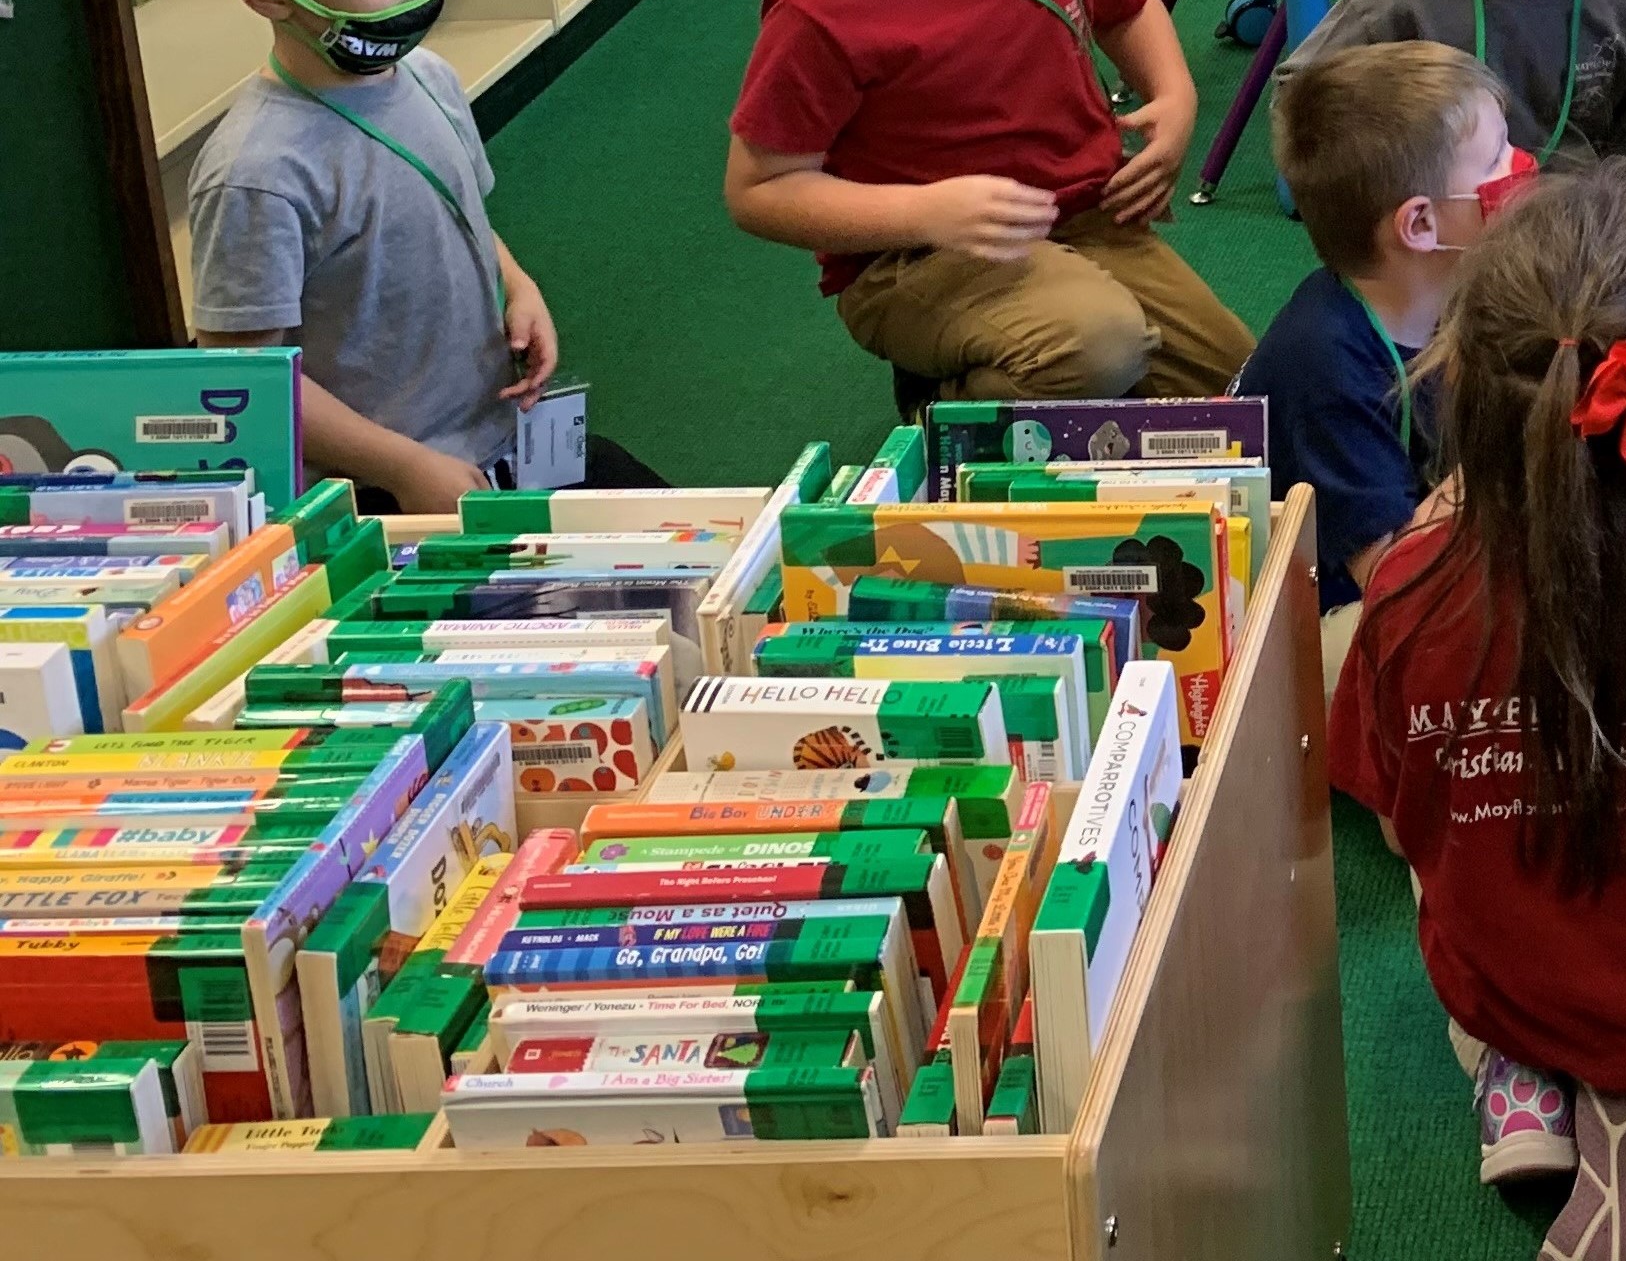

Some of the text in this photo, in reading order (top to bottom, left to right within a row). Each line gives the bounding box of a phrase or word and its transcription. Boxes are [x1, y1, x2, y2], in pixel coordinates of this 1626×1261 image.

[890, 638, 941, 652] Blue
[949, 637, 1016, 652] Little
[739, 685, 902, 706] HELLO HELLO
[1189, 672, 1211, 737] Highlights
[203, 736, 257, 747] TIGER
[1078, 720, 1137, 847] COMPARROTIVES
[115, 828, 218, 844] #baby
[650, 843, 726, 859] Stampede
[15, 870, 145, 885] Happy Giraffe!
[88, 890, 150, 907] FOX
[606, 900, 788, 924] Quiet as a Mouse
[521, 932, 600, 944] REYNOLDS MACK
[653, 928, 664, 940] IF
[664, 927, 681, 940] MY
[681, 927, 708, 939] LOVE
[709, 926, 735, 939] WERE
[736, 925, 746, 937] A
[16, 939, 81, 952] Tubby
[615, 943, 766, 968] Go, Grandpa, Go!
[525, 1000, 584, 1015] Weninger
[592, 1000, 636, 1012] Yonezu
[647, 999, 676, 1011] Time
[678, 999, 701, 1011] For
[629, 1040, 701, 1067] SANTA
[464, 1074, 515, 1091] Church
[611, 1073, 639, 1087] Am
[653, 1072, 682, 1088] Big
[689, 1070, 735, 1087] Sister!
[245, 1127, 292, 1141] Little
